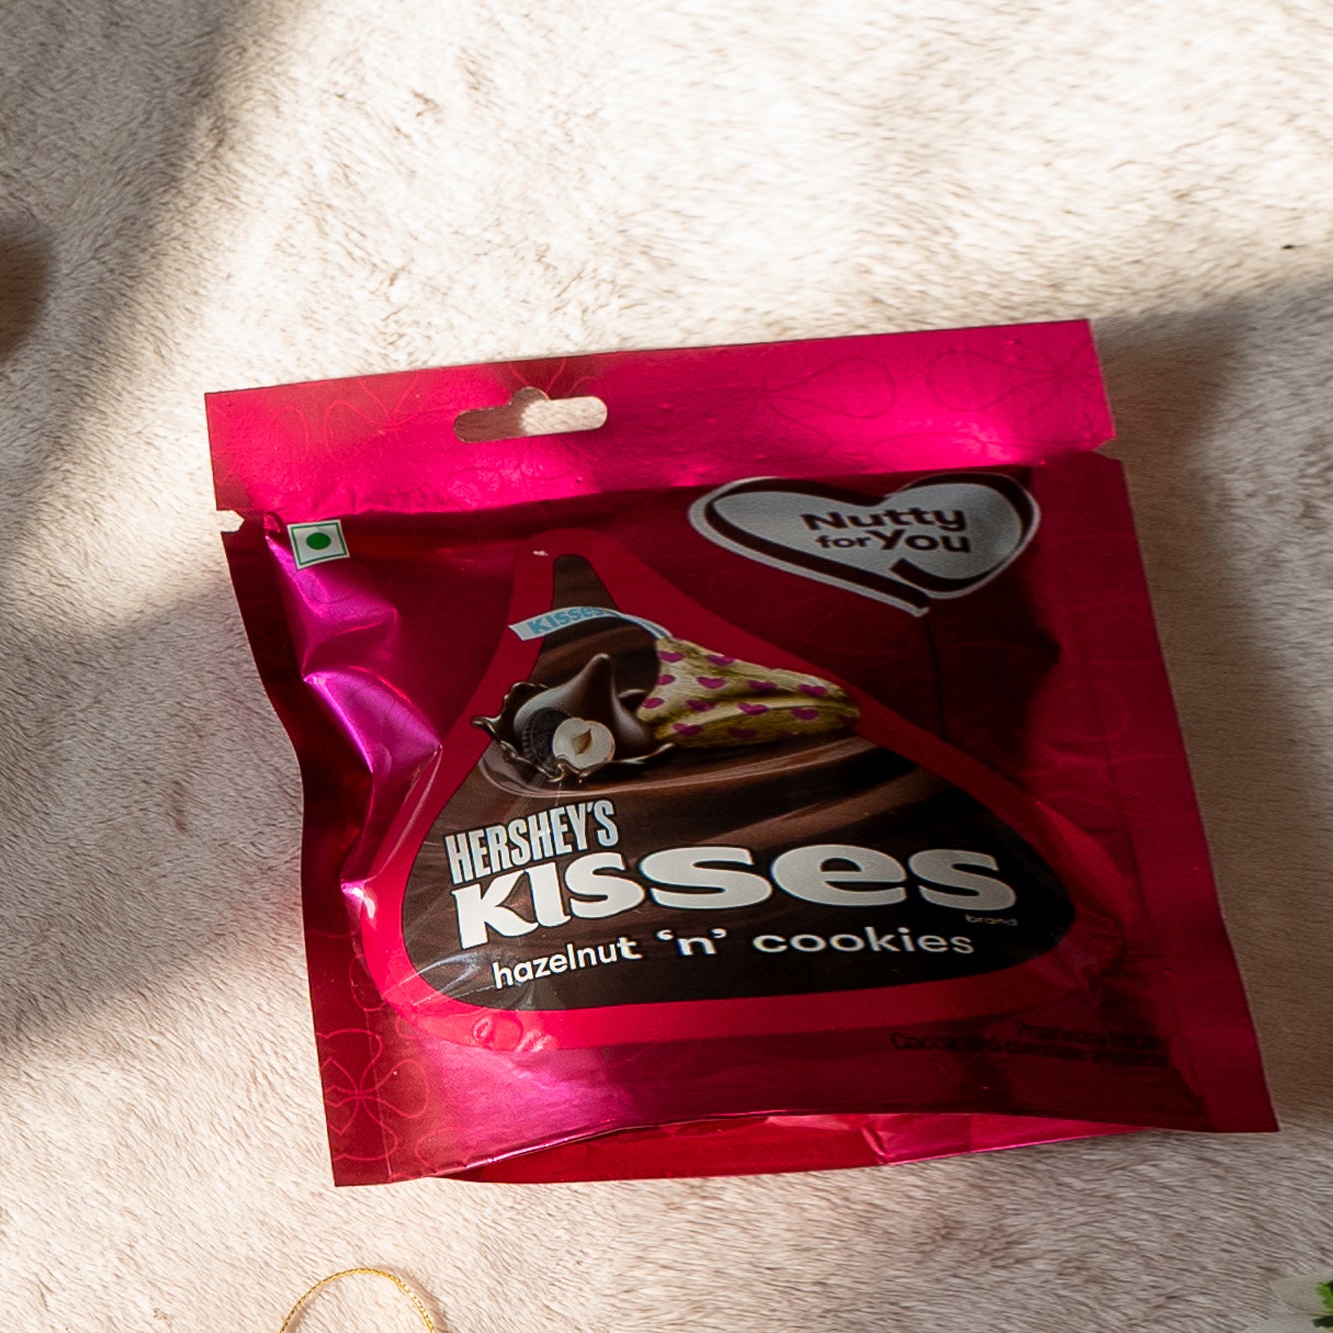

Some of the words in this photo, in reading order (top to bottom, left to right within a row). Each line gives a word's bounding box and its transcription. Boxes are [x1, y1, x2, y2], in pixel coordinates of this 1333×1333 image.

[799, 507, 967, 532] Nutty
[815, 535, 872, 548] for
[865, 528, 971, 553] You
[445, 800, 619, 884] HERSHEY'S
[965, 912, 1018, 926] brand
[492, 935, 644, 989] hazelnut
[752, 926, 975, 954] cookies
